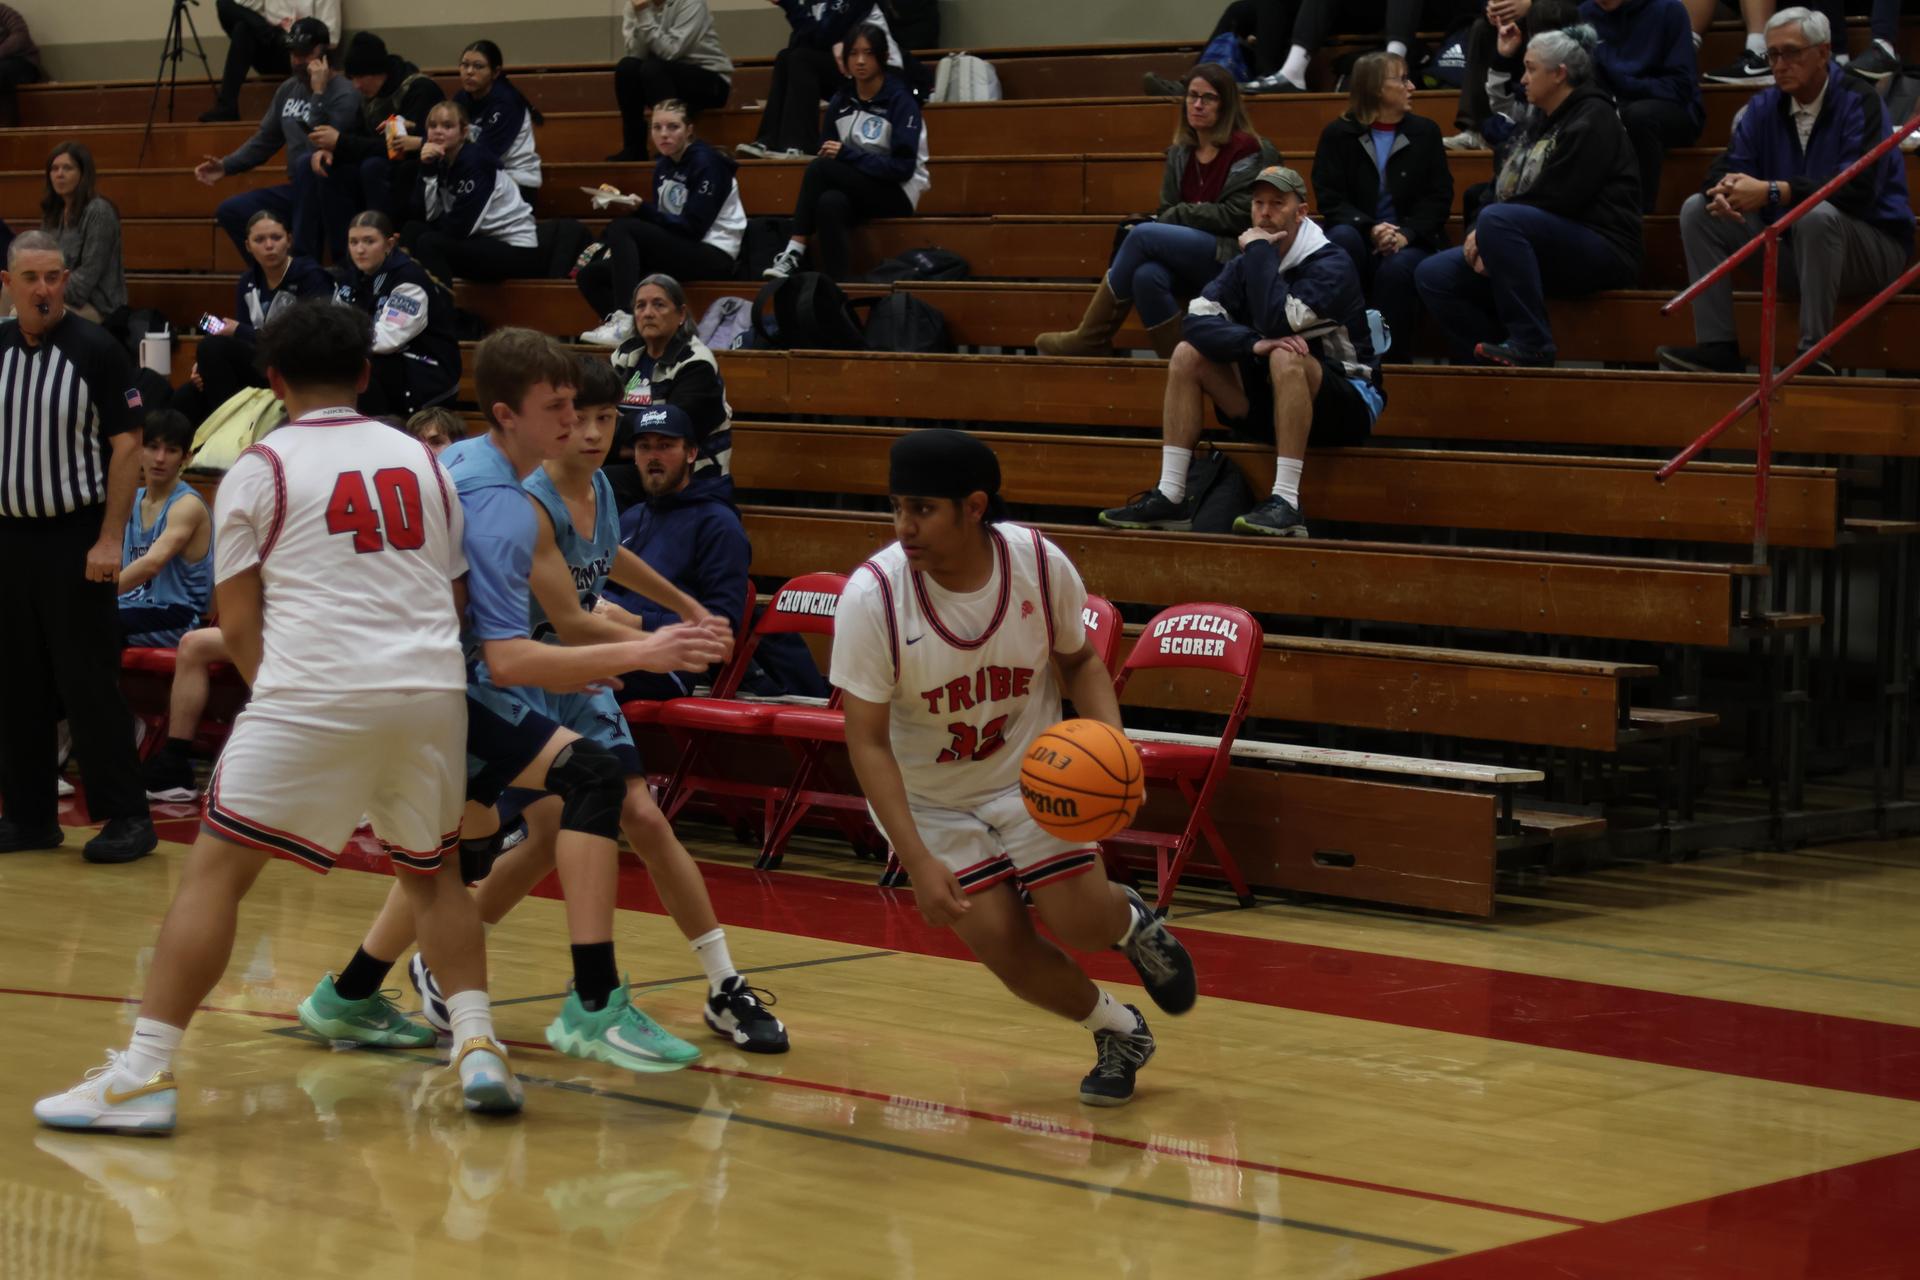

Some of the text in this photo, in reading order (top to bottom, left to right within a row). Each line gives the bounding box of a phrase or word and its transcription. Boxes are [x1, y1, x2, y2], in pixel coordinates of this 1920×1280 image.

[456, 180, 475, 194] 20
[325, 467, 426, 554] 40
[776, 589, 839, 617] CHOWCHIL
[1152, 614, 1239, 643] OFFICIAL
[1159, 637, 1226, 657] SCORER
[920, 665, 1034, 714] TRIBE
[1021, 783, 1079, 818] Wilso
